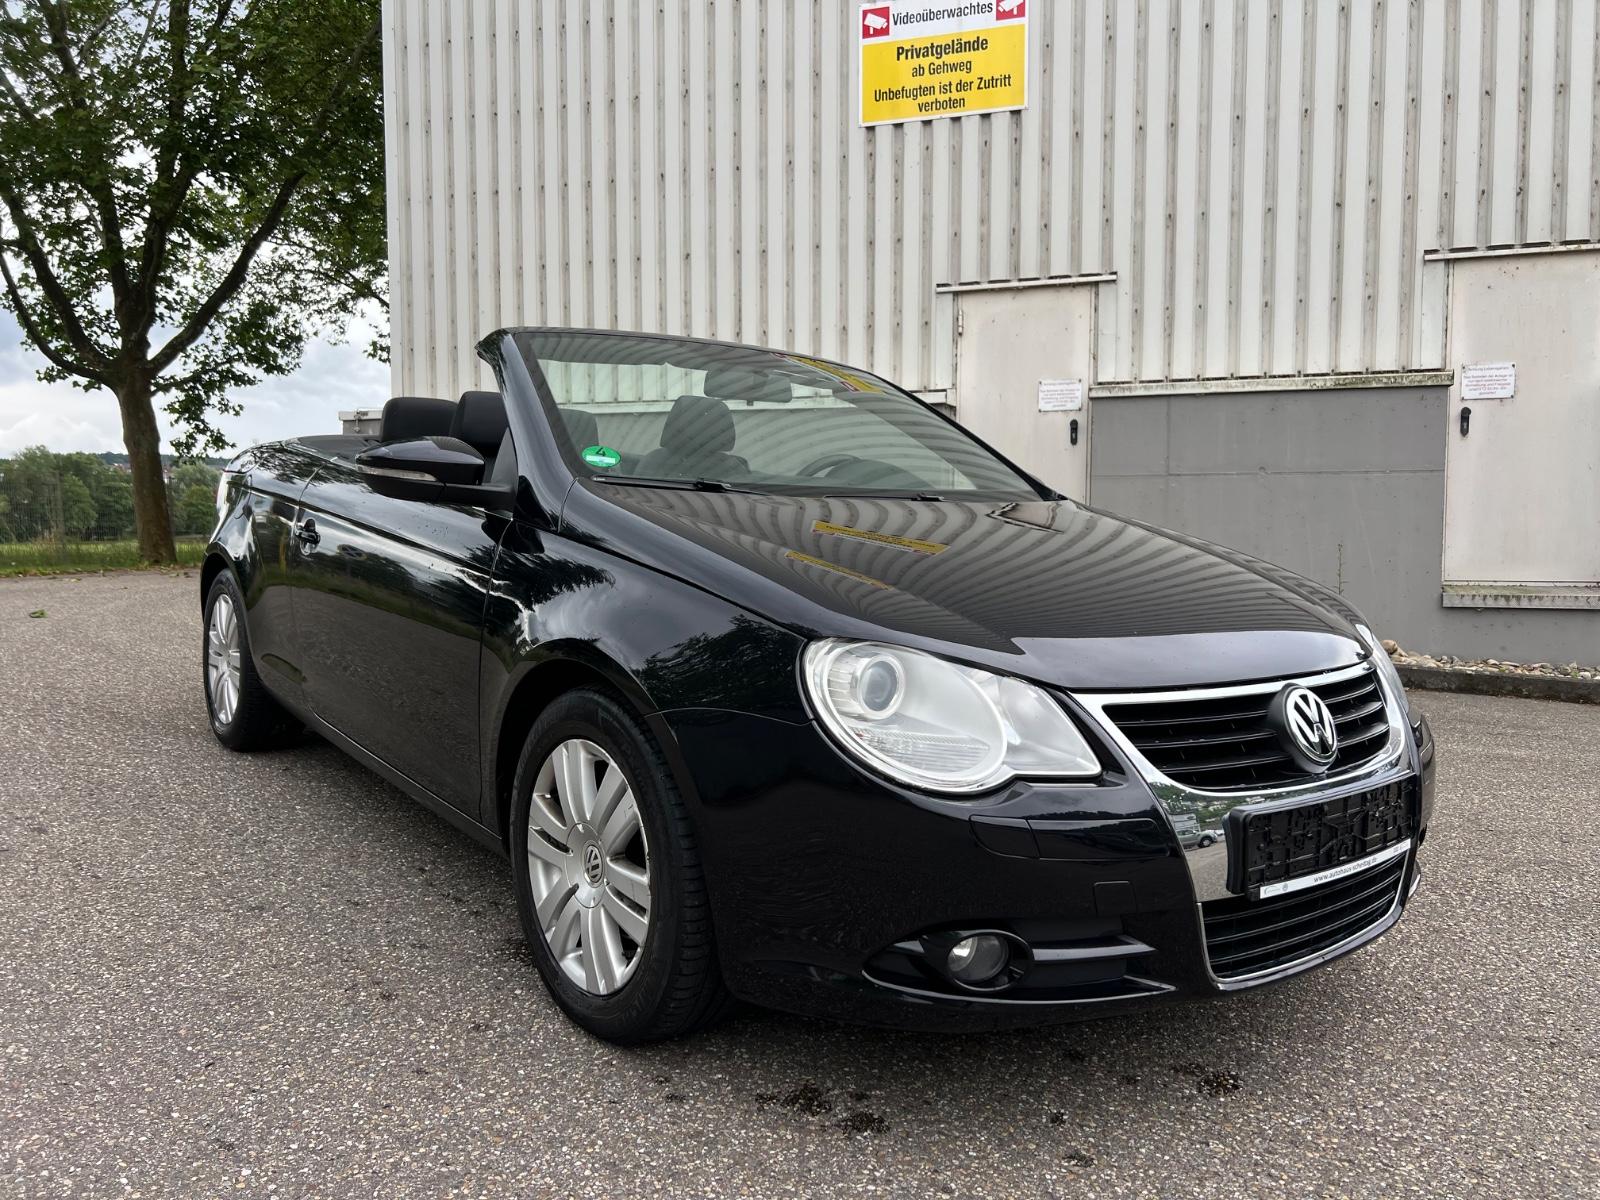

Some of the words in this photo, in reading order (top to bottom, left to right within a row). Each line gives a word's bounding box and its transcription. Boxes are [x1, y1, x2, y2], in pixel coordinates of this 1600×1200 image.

[892, 2, 993, 26] Videoüberwachtes
[896, 36, 988, 61] Privatgelände
[911, 65, 925, 78] ab
[928, 60, 972, 76] Gehweg
[874, 84, 936, 103] Unbefugten
[938, 81, 952, 95] ist
[955, 79, 974, 92] der
[976, 74, 1012, 90] Zutritt
[918, 97, 966, 112] verboten
